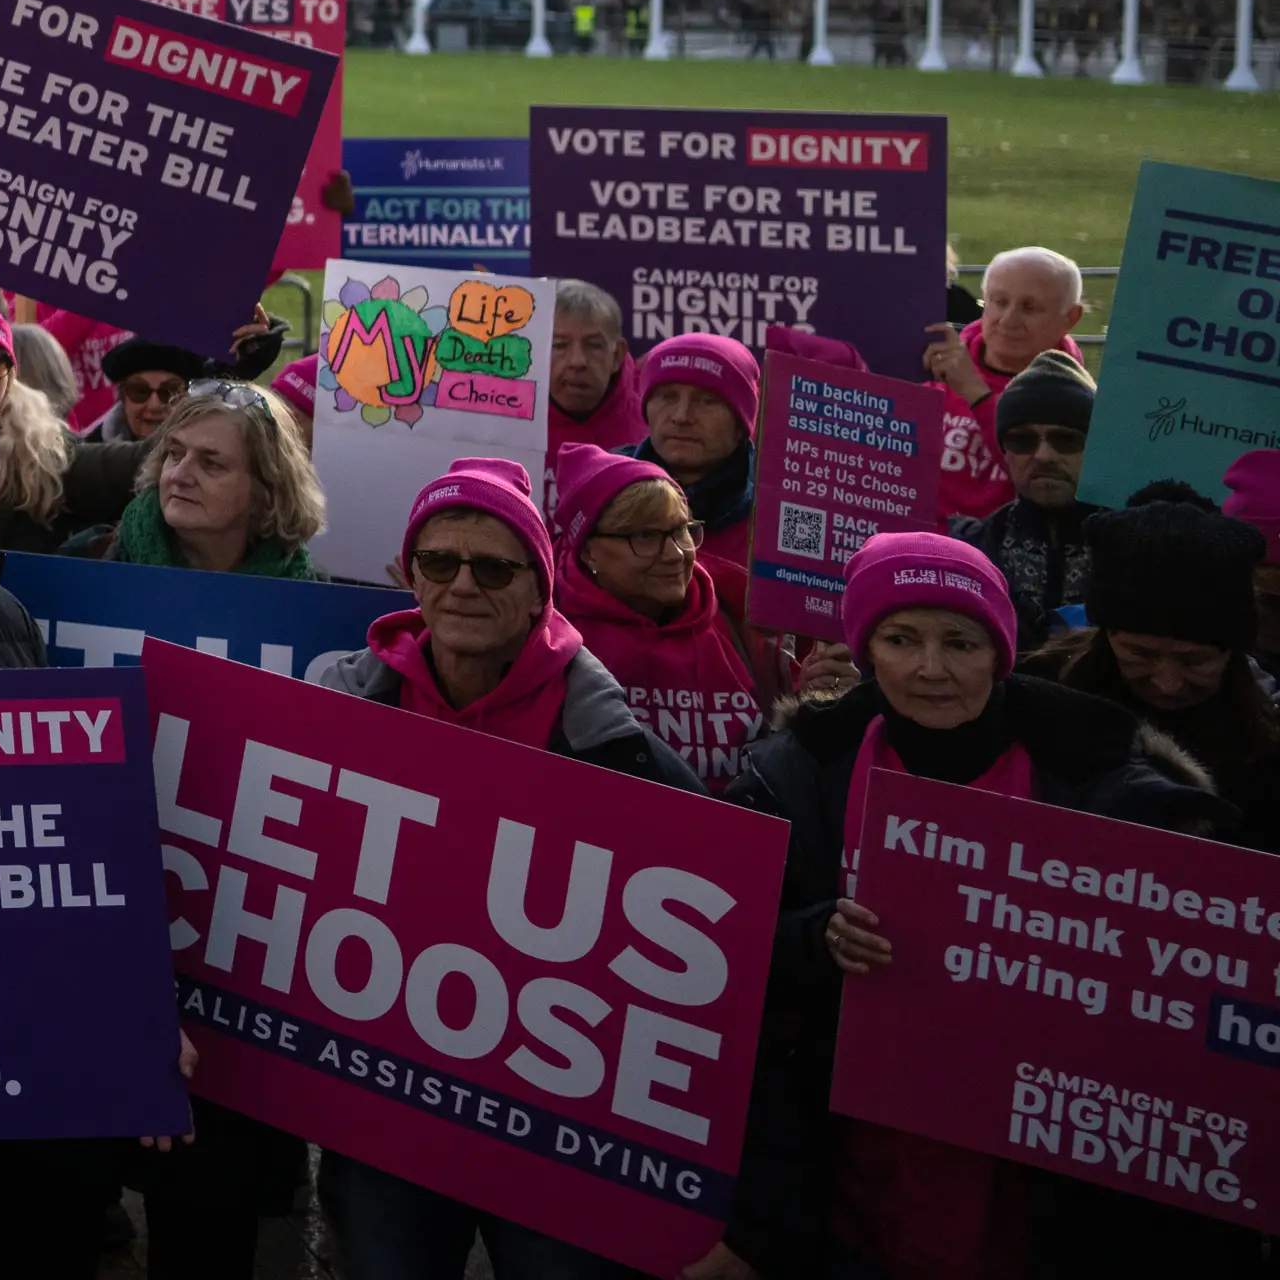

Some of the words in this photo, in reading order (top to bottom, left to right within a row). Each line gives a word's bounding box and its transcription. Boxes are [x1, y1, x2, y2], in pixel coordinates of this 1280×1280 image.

[111, 26, 303, 107] DIGNITY
[41, 71, 131, 126] FOR
[146, 101, 235, 158] THE
[419, 157, 486, 170] Humanists
[487, 157, 504, 170] UK
[548, 128, 645, 157] VOTE
[659, 131, 736, 161] FOR
[750, 134, 921, 166] DIGNITY
[161, 151, 258, 211] BILL
[590, 180, 690, 211] VOTE
[704, 185, 781, 215] FOR
[796, 188, 878, 218] THE
[365, 198, 420, 220] ACT
[425, 199, 481, 220] FOR
[486, 199, 530, 220] TH
[344, 223, 519, 246] TERMINALLY
[556, 212, 811, 250] LEADBEATER
[827, 224, 917, 254] BILL
[1156, 230, 1280, 281] FREE
[456, 293, 524, 337] Life
[330, 306, 437, 405] My
[439, 335, 516, 370] Death
[1167, 316, 1280, 366] CHO
[448, 381, 522, 408] Choice
[790, 392, 817, 413] law
[823, 404, 884, 429] change
[890, 419, 910, 435] on
[791, 374, 817, 395] I'm
[823, 385, 889, 413] backing
[788, 413, 860, 443] assisted
[866, 432, 913, 457] dying
[784, 456, 799, 472] to
[805, 461, 830, 480] Let
[836, 468, 856, 486] Us
[861, 473, 917, 500] Choose
[786, 438, 819, 458] MPs
[824, 449, 863, 469] must
[869, 459, 902, 477] vote
[782, 478, 801, 492] on
[806, 480, 828, 497] 29
[833, 490, 912, 517] November
[833, 513, 879, 534] BACK
[894, 569, 916, 578] LET
[920, 570, 936, 578] US
[894, 577, 938, 585] CHOOSE
[805, 603, 832, 614] CHOOSE
[153, 712, 441, 906] LET
[486, 817, 738, 1008] US
[883, 815, 987, 870] Kim
[1007, 842, 1280, 941] Leadbeat
[958, 884, 1126, 959] Thank
[1145, 937, 1249, 989] you
[943, 943, 1109, 1016] giving
[1131, 989, 1195, 1031] us
[1218, 1005, 1280, 1054] ho
[175, 981, 300, 1053] ALISE
[317, 1039, 535, 1139] ASSISTED
[554, 1125, 705, 1201] DYING
